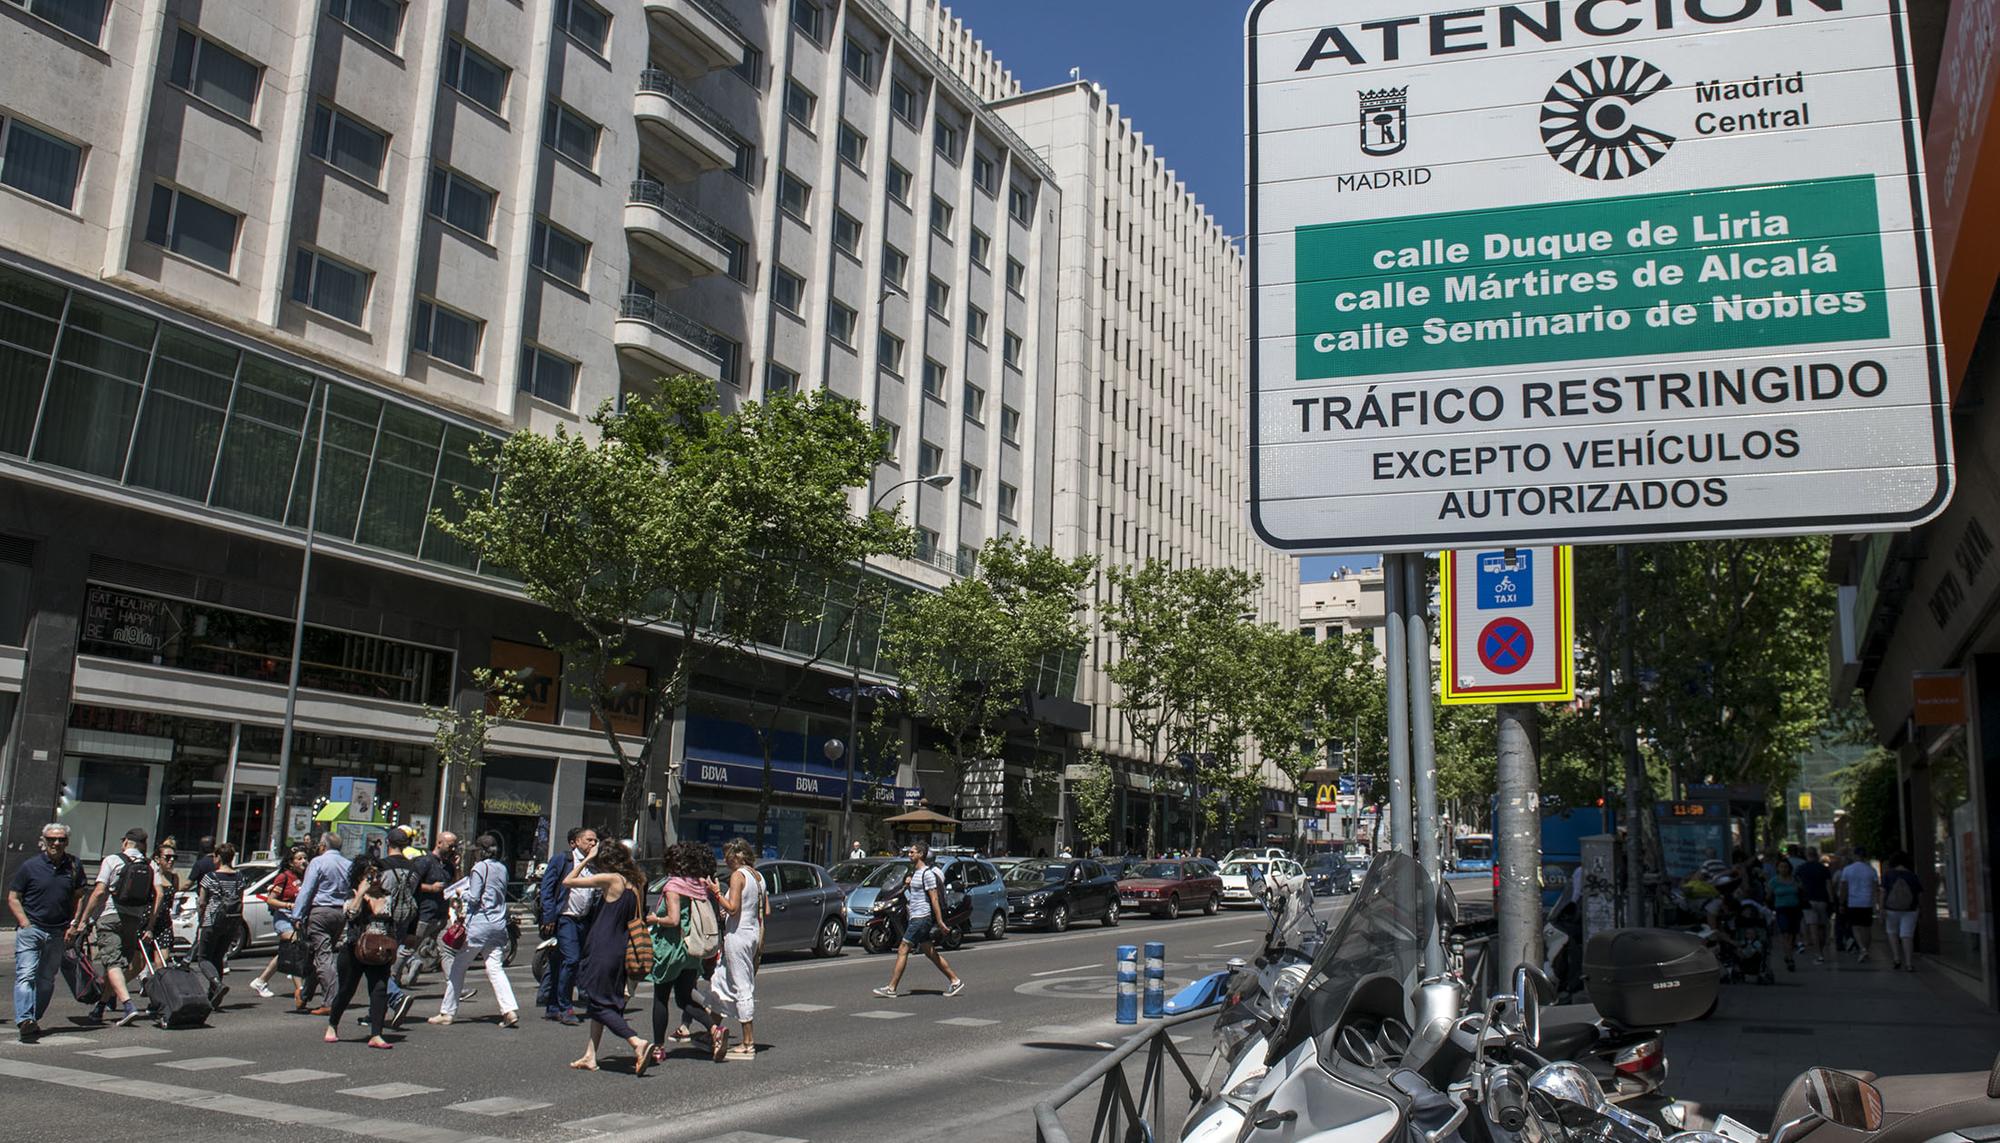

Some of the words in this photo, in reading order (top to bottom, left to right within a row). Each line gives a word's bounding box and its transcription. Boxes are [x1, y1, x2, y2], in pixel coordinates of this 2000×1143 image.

[1696, 71, 1804, 104] Madrid
[1695, 103, 1810, 135] Central
[1338, 167, 1431, 193] MADRID
[1373, 239, 1469, 270] calle
[1484, 230, 1613, 260] Duque
[1627, 220, 1678, 248] de
[1693, 211, 1789, 243] Liria
[1334, 281, 1430, 312] calle
[1444, 269, 1618, 303] Mártires
[1632, 260, 1684, 288] de
[1698, 245, 1837, 282] Alcalá
[1313, 323, 1409, 353] calle
[1423, 305, 1631, 345] Seminario
[1646, 300, 1697, 328] de
[1713, 289, 1866, 323] Nobles
[1292, 385, 1504, 432] TRÁFICO
[1522, 360, 1888, 419] RESTRINGIDO
[1373, 443, 1551, 480] EXCEPTO
[1563, 429, 1800, 472] VEHÍCULOS
[1438, 478, 1728, 520] AUTORIZADOS
[91, 591, 110, 604] EAT
[115, 596, 156, 613] HEALTHY
[1494, 594, 1517, 604] TAXI
[87, 623, 104, 639] BE
[89, 605, 112, 620] LIVE
[118, 610, 155, 626] HAPPY
[701, 765, 728, 782] BBVA
[796, 777, 818, 793] BBVA
